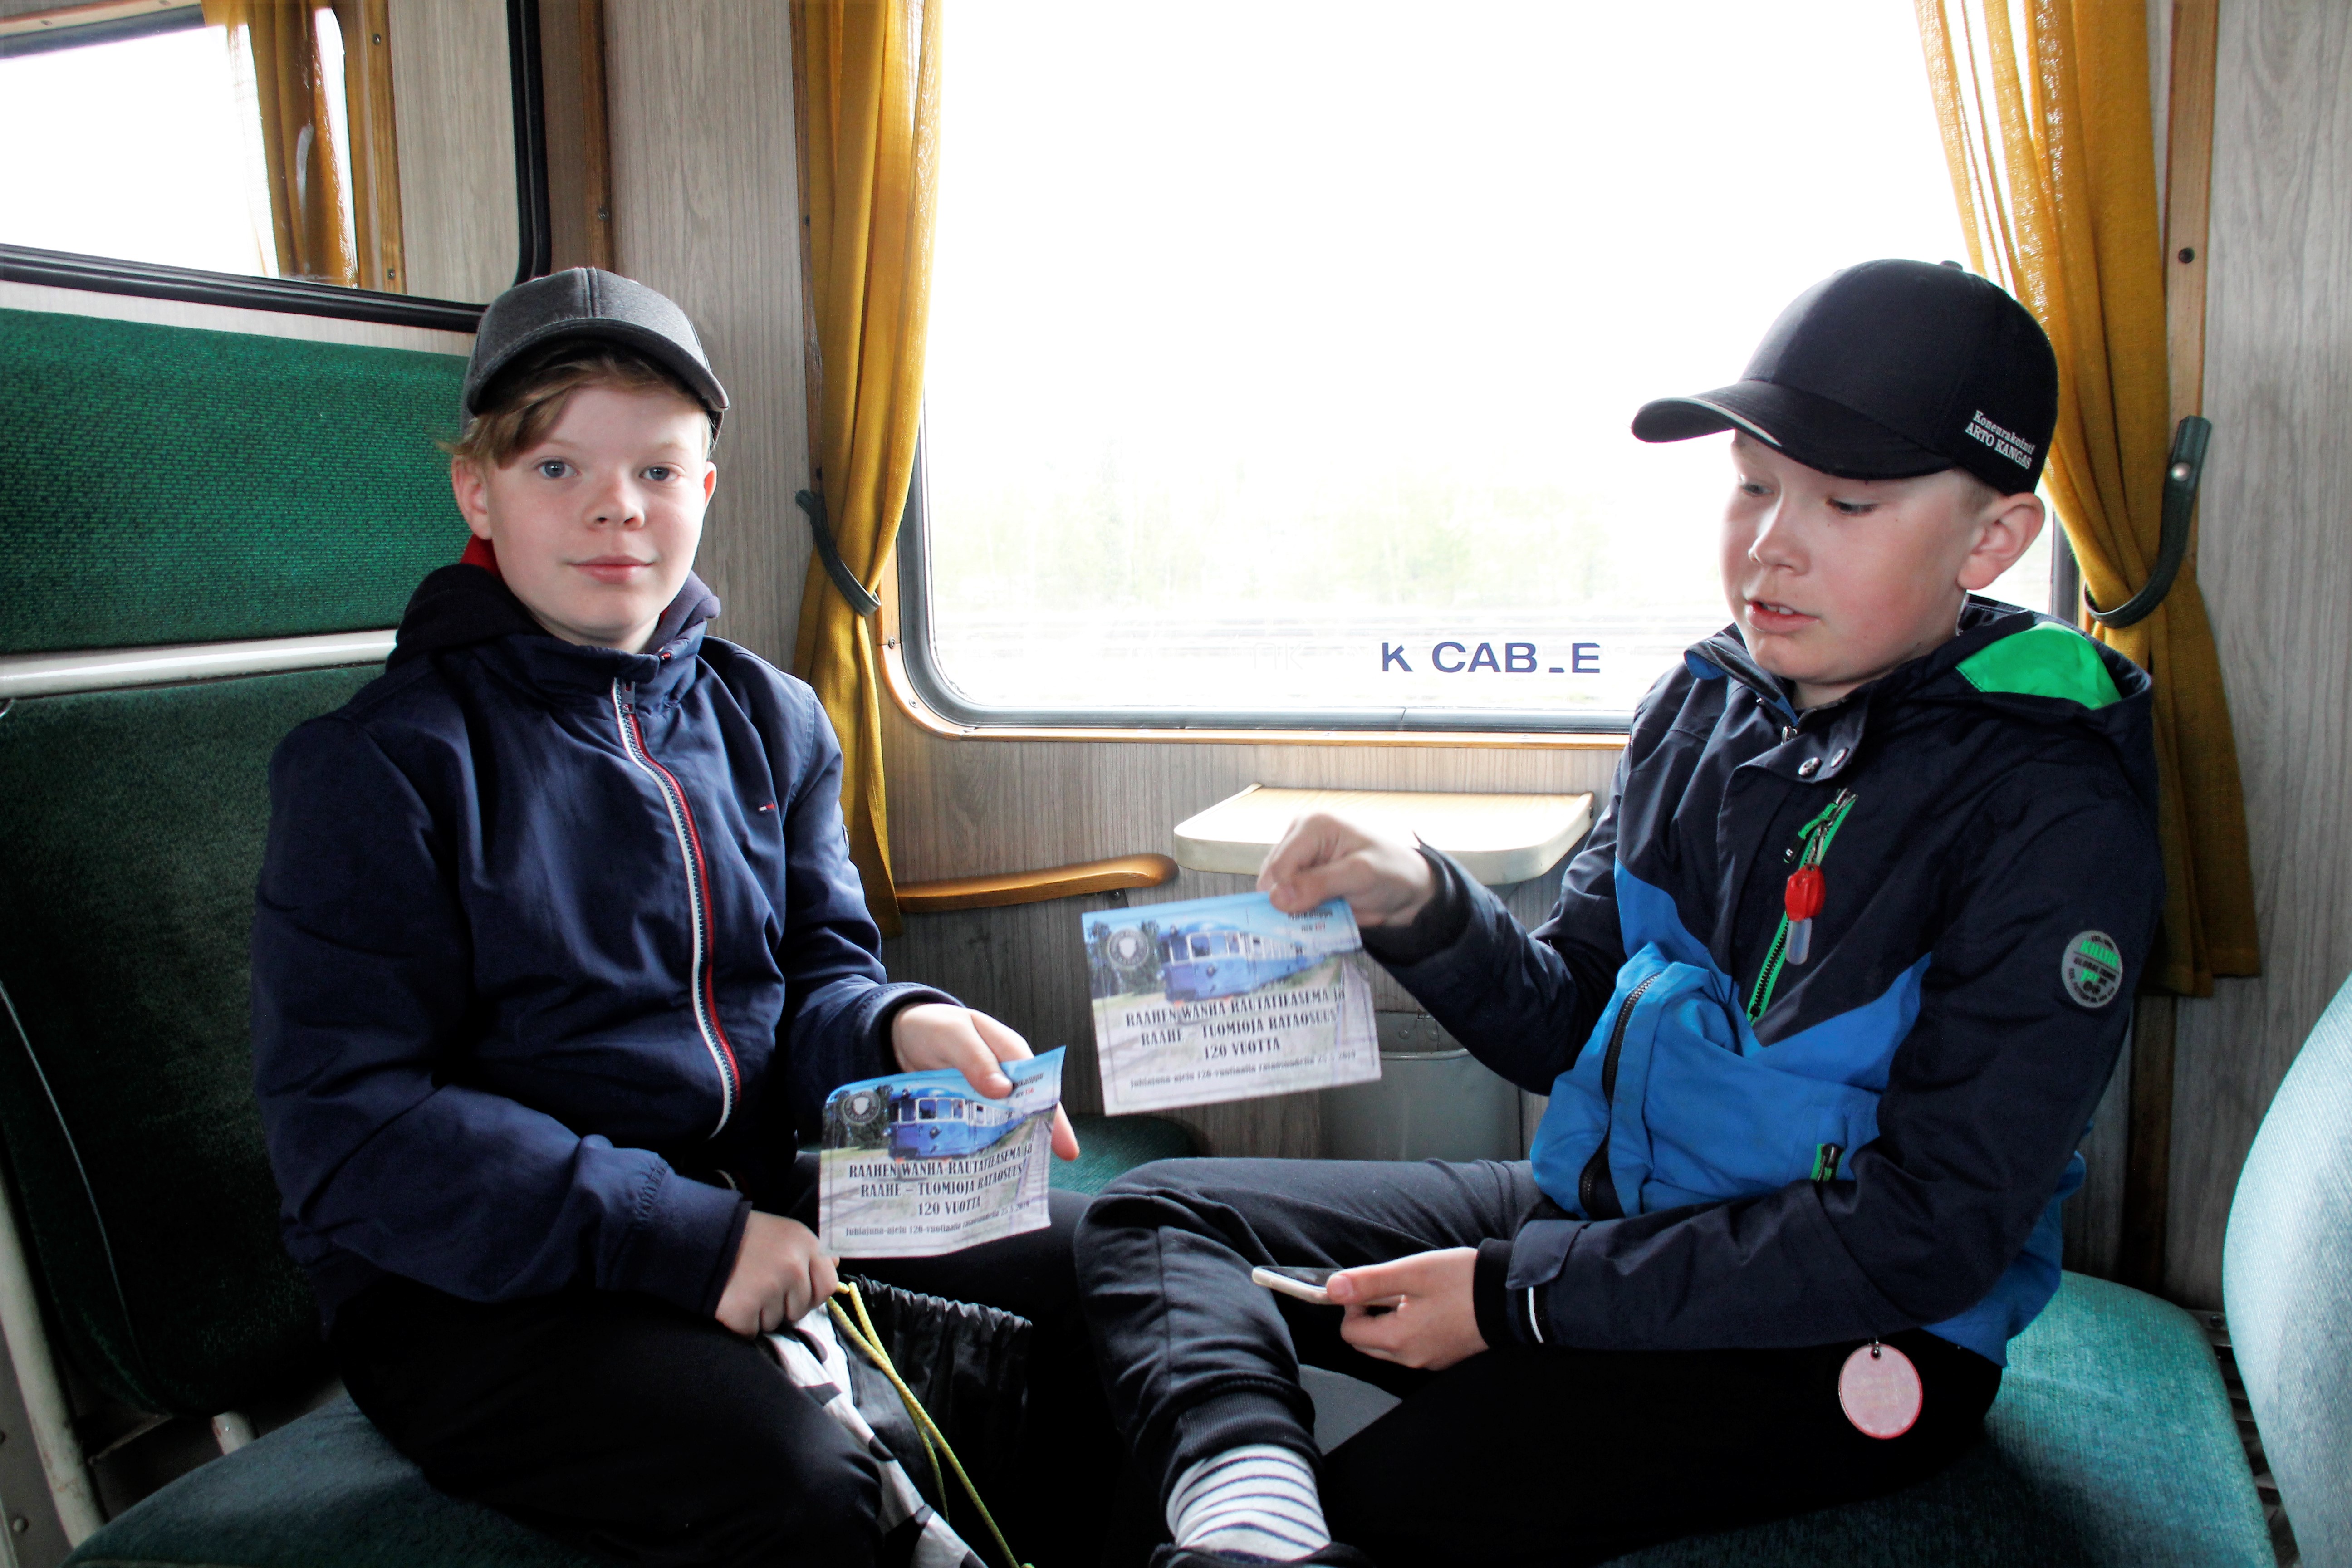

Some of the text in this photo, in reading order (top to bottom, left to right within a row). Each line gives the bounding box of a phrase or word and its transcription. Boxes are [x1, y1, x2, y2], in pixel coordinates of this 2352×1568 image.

[1965, 422, 2032, 469] ARTO KANGAS
[1382, 642, 1413, 672] K
[1126, 1008, 1177, 1027] RAAHEN
[1181, 1001, 1225, 1019] WANHA
[1141, 1028, 1185, 1046] RAAHE
[1205, 1037, 1280, 1060] 120 VUOTTA
[849, 1163, 897, 1178] RAAHEN
[901, 1161, 943, 1176] WANHA
[948, 1146, 1021, 1175] RAUTATIEASEMA
[861, 1183, 901, 1197] RAAHE
[918, 1180, 975, 1196] TUOMIOJA
[977, 1163, 1023, 1191] RATAOSUUS
[918, 1196, 981, 1215] 120 VUOTTA
